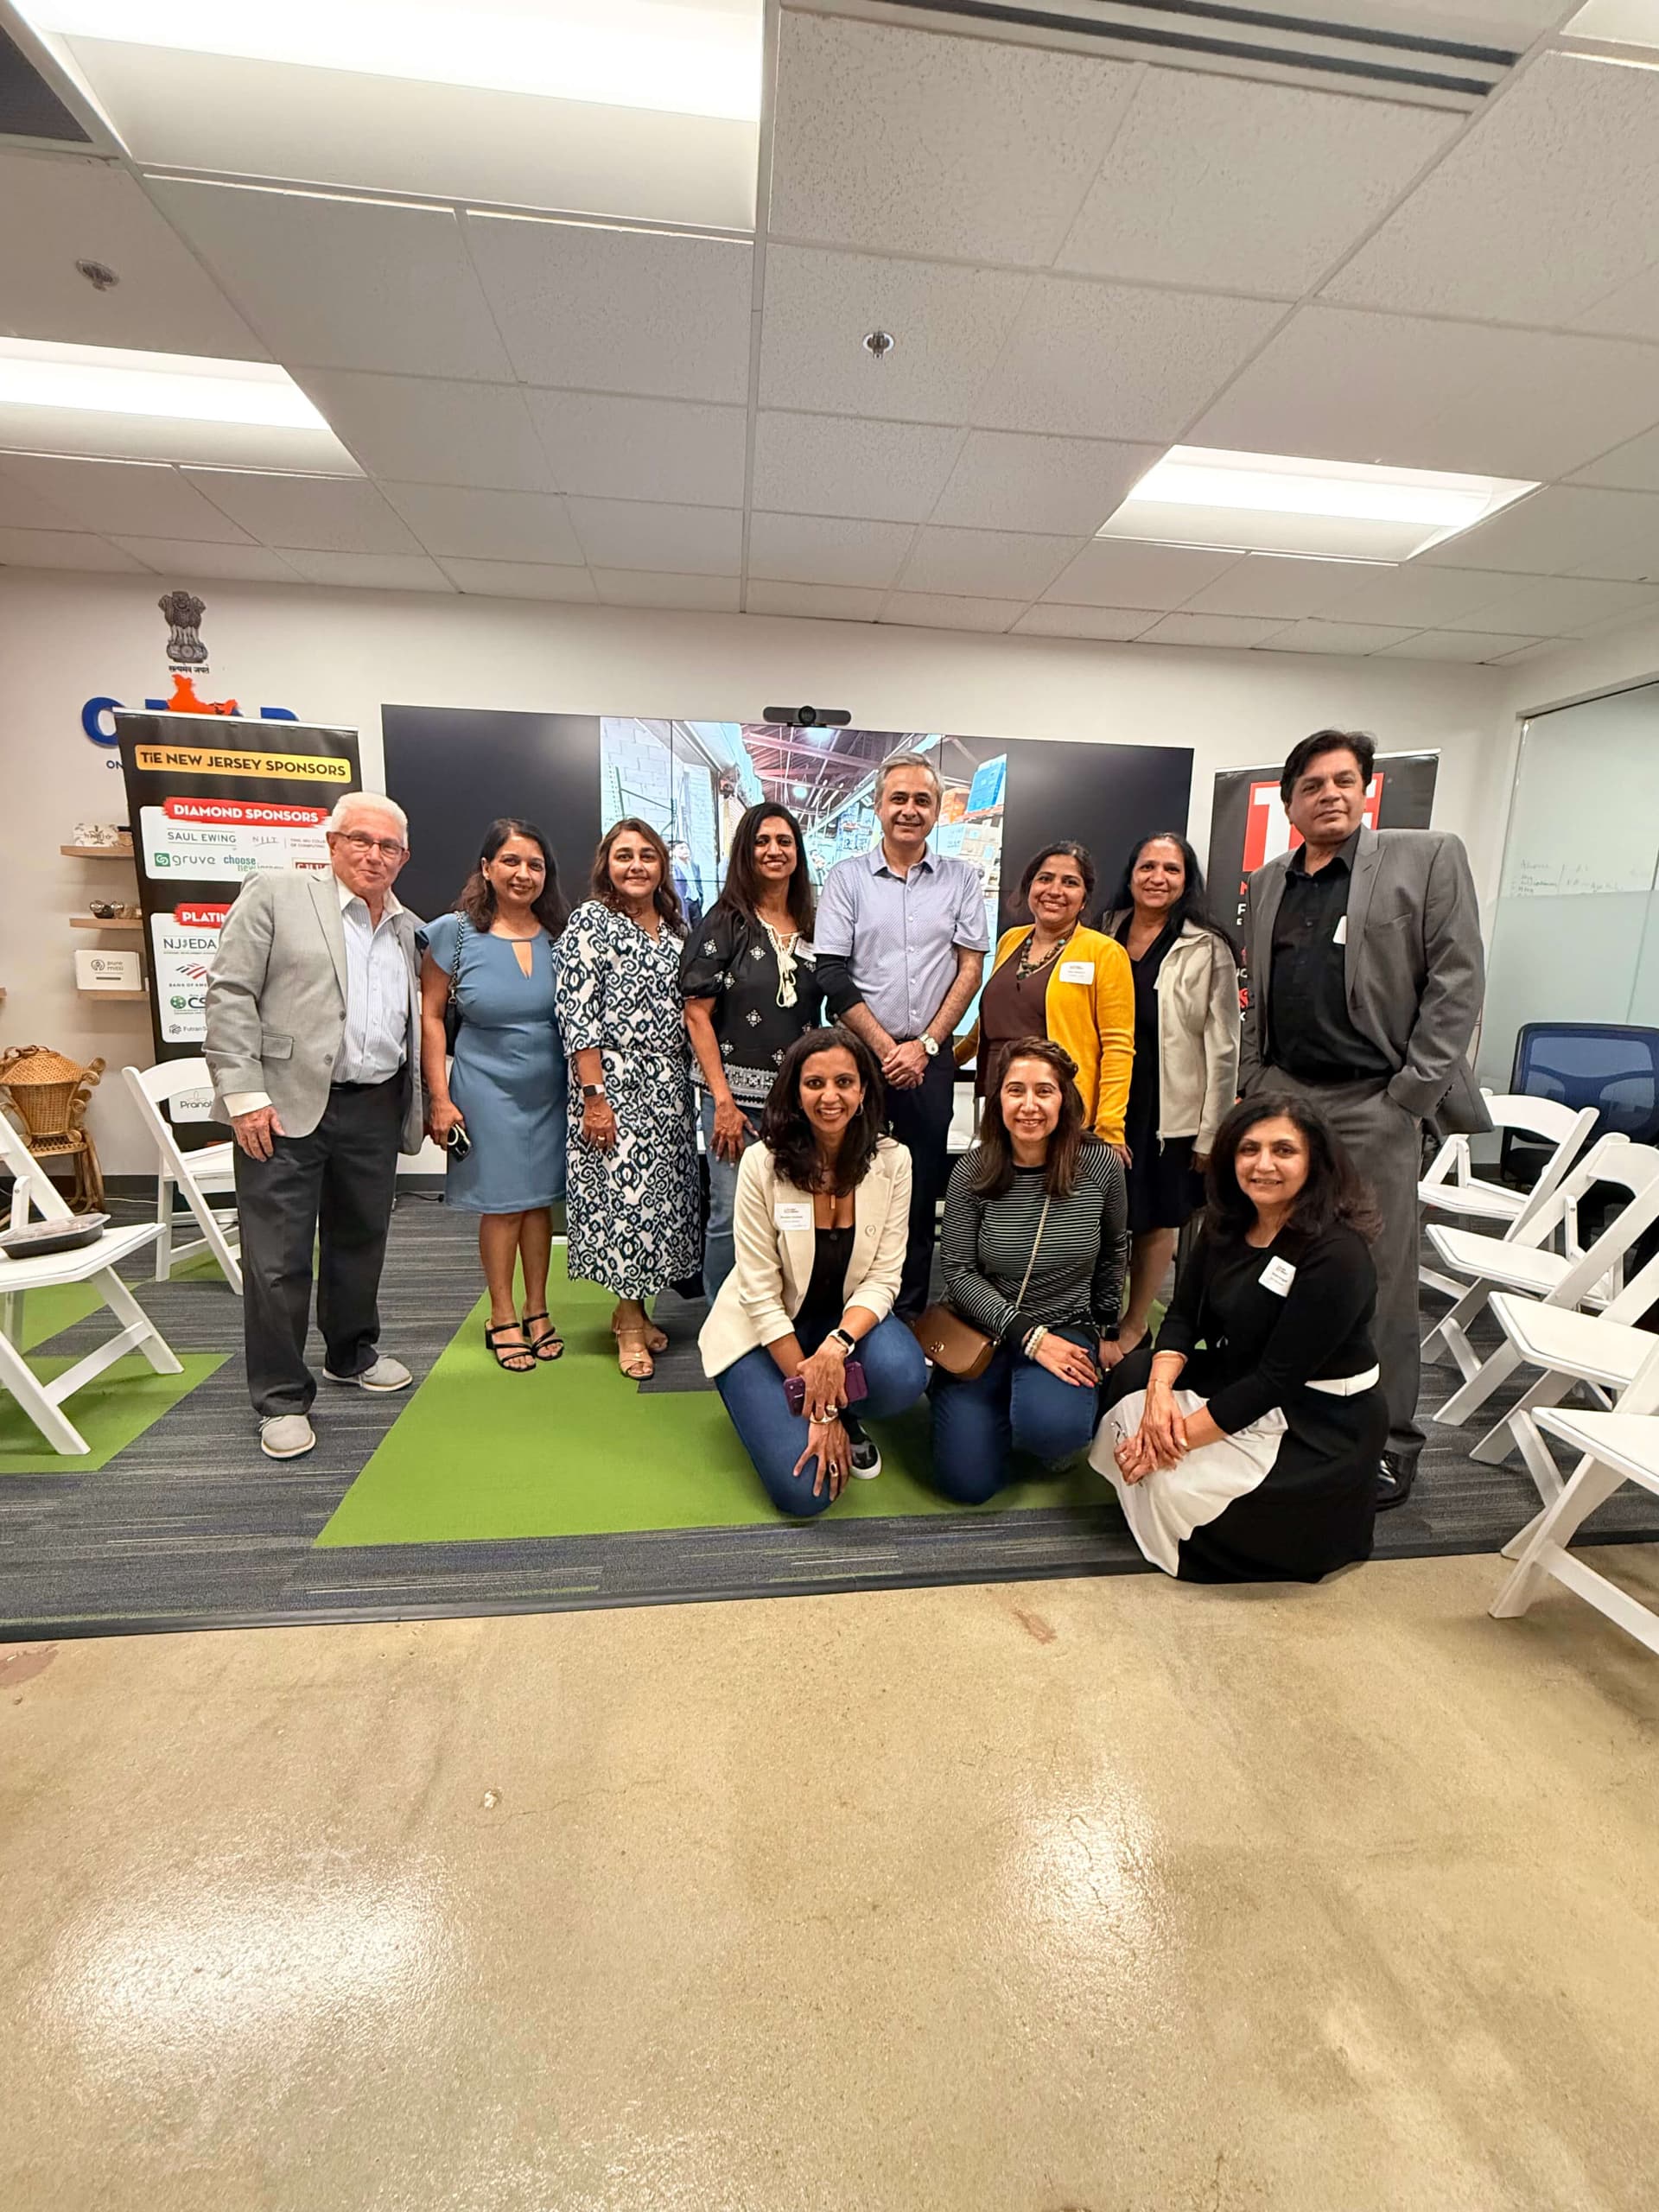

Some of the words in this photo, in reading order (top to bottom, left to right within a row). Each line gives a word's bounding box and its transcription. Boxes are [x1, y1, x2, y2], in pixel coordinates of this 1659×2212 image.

[140, 752, 162, 764] TiE
[166, 753, 202, 766] NEW
[207, 756, 262, 770] JERSEY
[266, 760, 346, 776] SPONSORS
[173, 804, 243, 819] DIAMOND
[245, 808, 319, 823] SPONSORS
[168, 831, 199, 842] SAUL
[201, 833, 237, 843] EWING
[172, 855, 216, 866] gruve
[224, 855, 257, 865] choose
